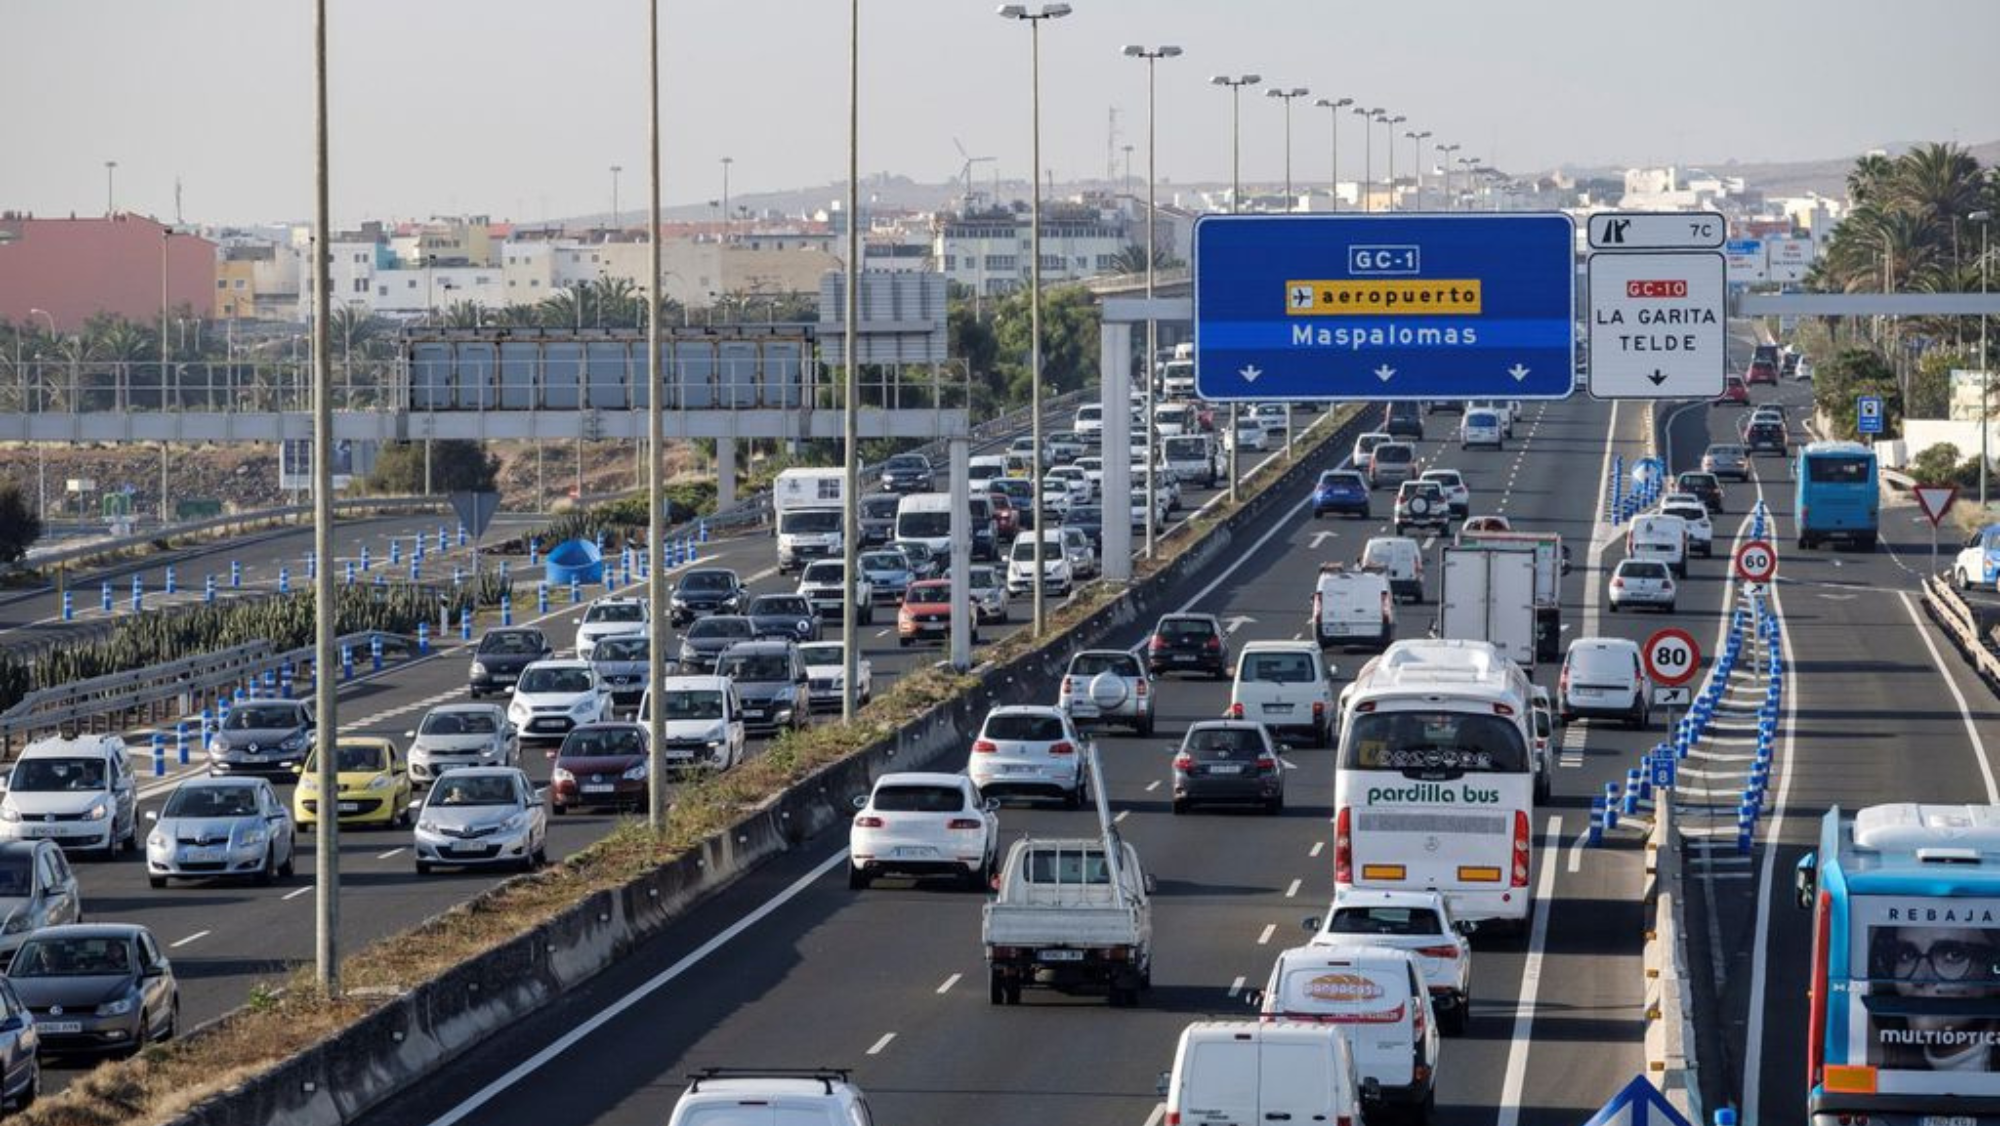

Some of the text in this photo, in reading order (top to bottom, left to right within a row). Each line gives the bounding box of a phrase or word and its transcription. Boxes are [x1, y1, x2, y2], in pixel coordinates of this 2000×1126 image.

[1689, 224, 1712, 238] 7C
[1356, 251, 1416, 269] GC-1
[1627, 281, 1687, 297] GC-10
[1322, 288, 1476, 307] aeropuerto
[1597, 309, 1717, 324] LA GARITA
[1292, 325, 1478, 350] Maspalomas
[1619, 336, 1697, 351] TELDE
[1745, 554, 1767, 569] 60
[1657, 647, 1686, 666] 80
[1367, 784, 1500, 806] pardilla bus
[1888, 908, 1993, 922] REBAJA
